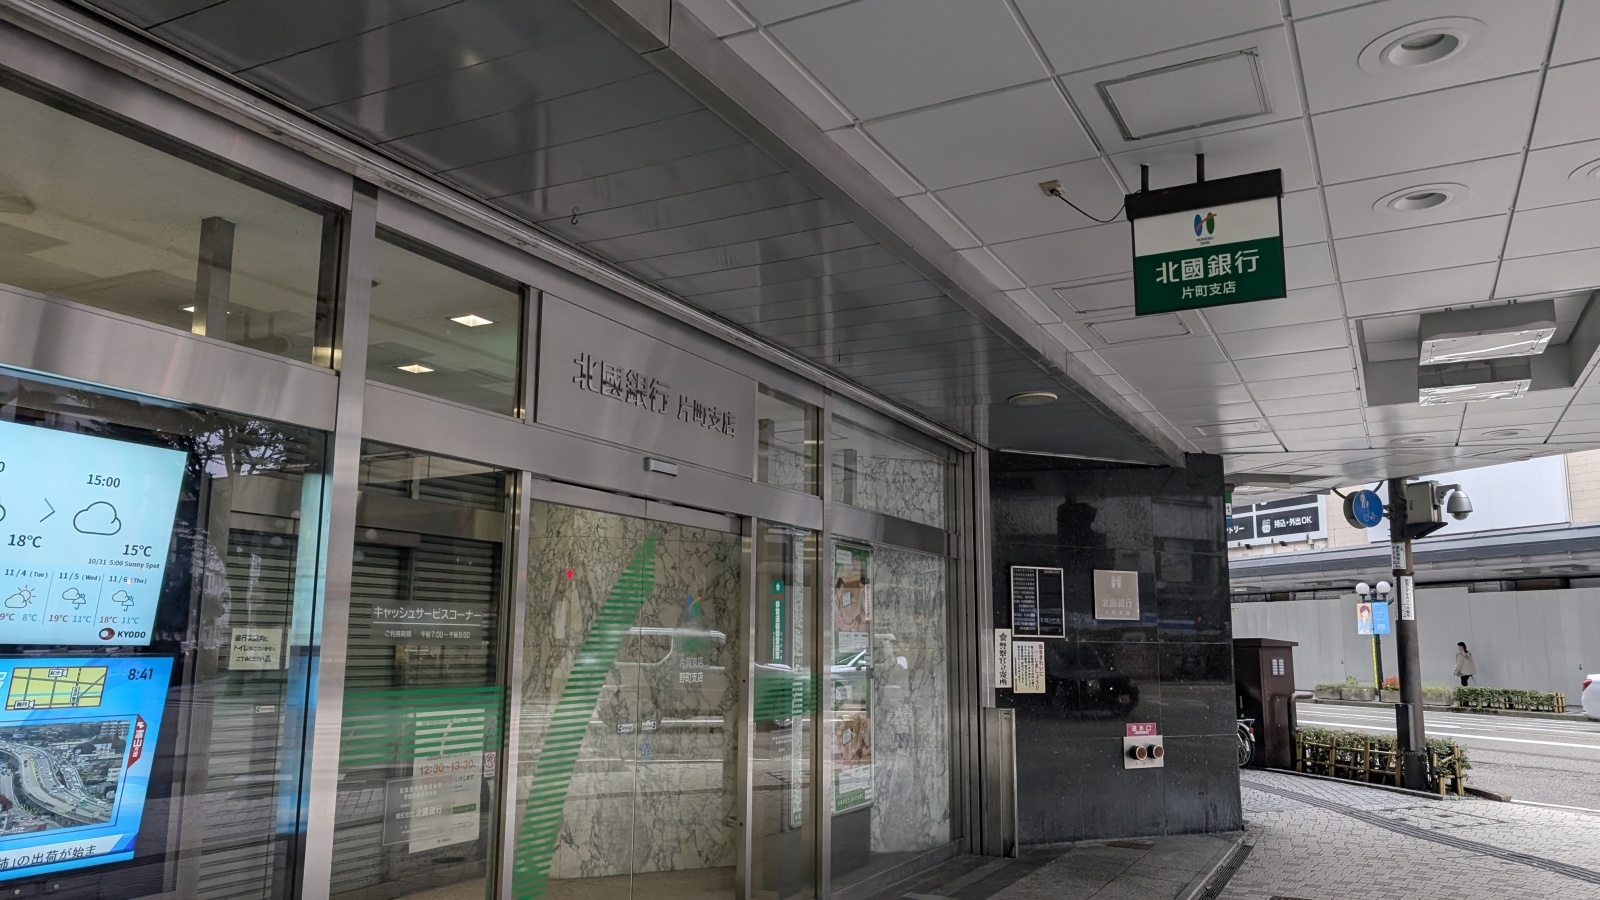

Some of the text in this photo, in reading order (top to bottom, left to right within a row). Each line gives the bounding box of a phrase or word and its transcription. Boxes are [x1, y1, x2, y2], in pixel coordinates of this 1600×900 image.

[1155, 249, 1260, 284] 北國銀行
[1181, 281, 1236, 299] 片町支店
[572, 352, 736, 437] 北國銀行 片町支店
[87, 474, 121, 488] 15:00
[1226, 525, 1245, 534] トリー
[7, 534, 42, 548] 18°C
[122, 544, 152, 557] 15°C
[88, 558, 107, 566] 10/31
[109, 559, 124, 567] 5:00
[124, 560, 144, 569] Sunny
[373, 605, 481, 620] キャッシュサービスコーナー
[117, 630, 146, 639] KYODO
[384, 630, 412, 638] ご利用時間
[127, 667, 154, 680] 8:41
[679, 671, 704, 684] 野町支店
[415, 804, 443, 818] 北國銀行
